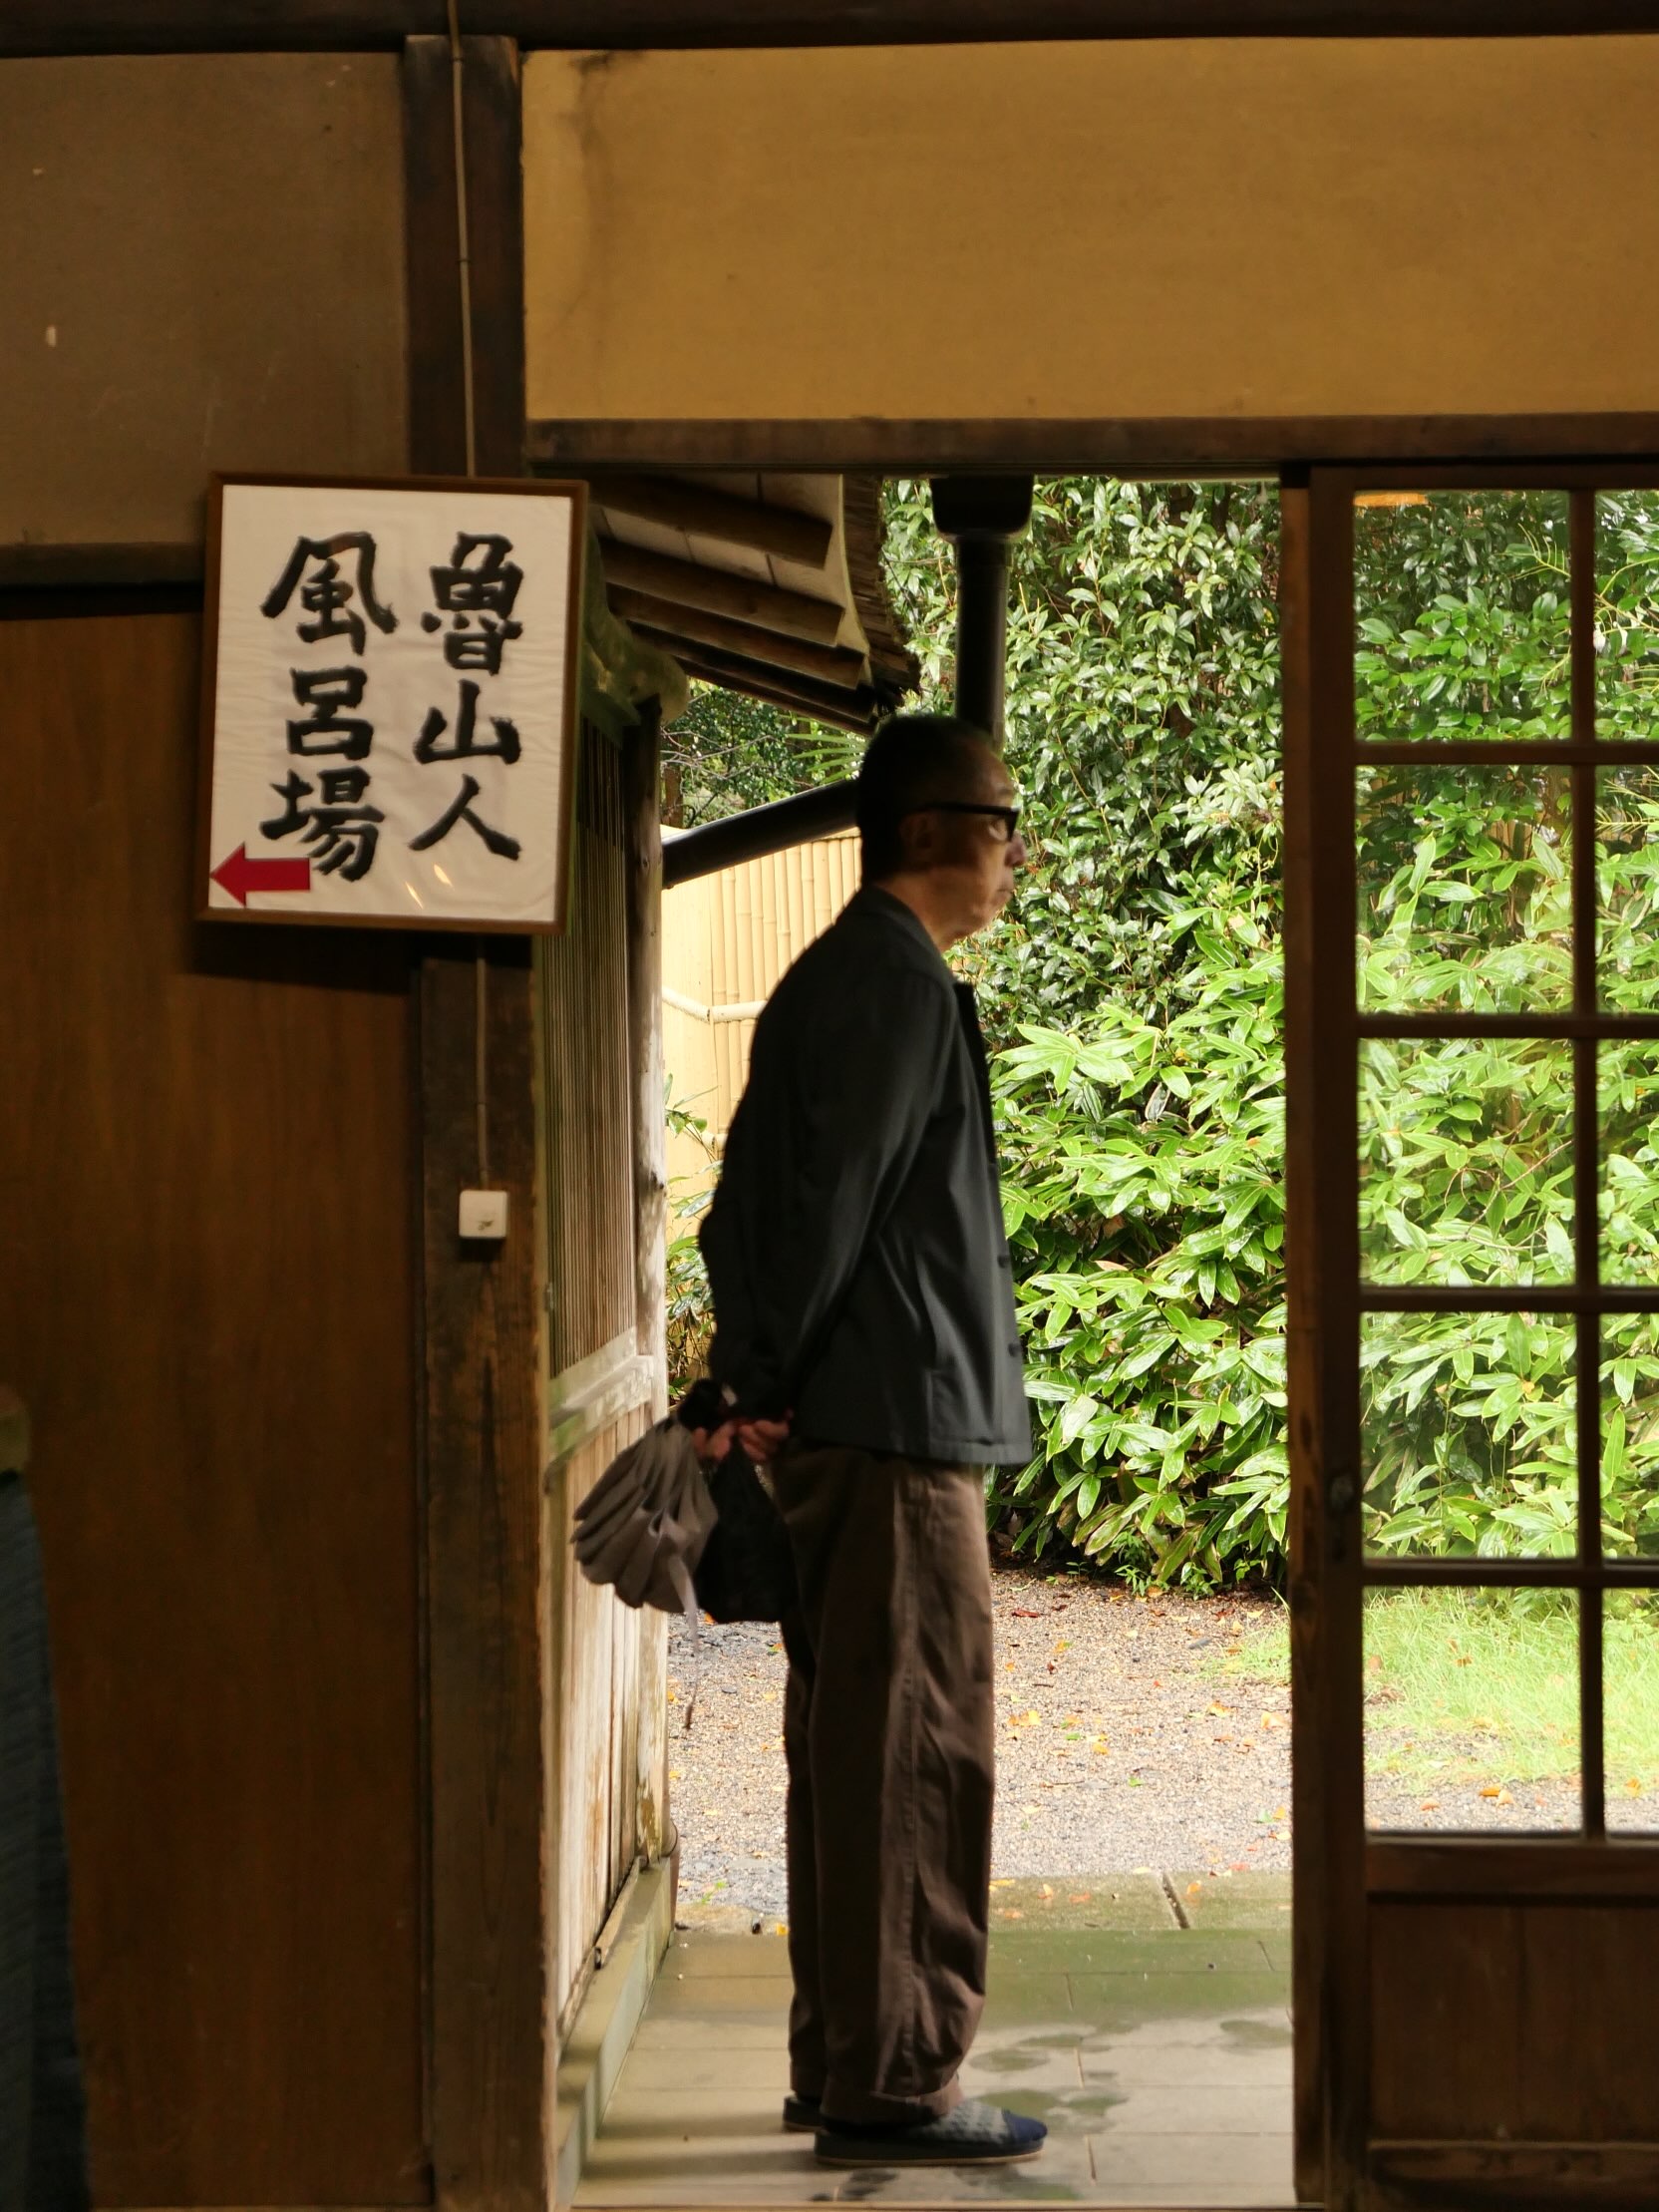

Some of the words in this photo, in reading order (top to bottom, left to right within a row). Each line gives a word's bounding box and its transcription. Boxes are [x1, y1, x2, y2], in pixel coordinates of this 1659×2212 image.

[259, 531, 399, 883] 風呂場
[409, 532, 524, 863] 魯山人
